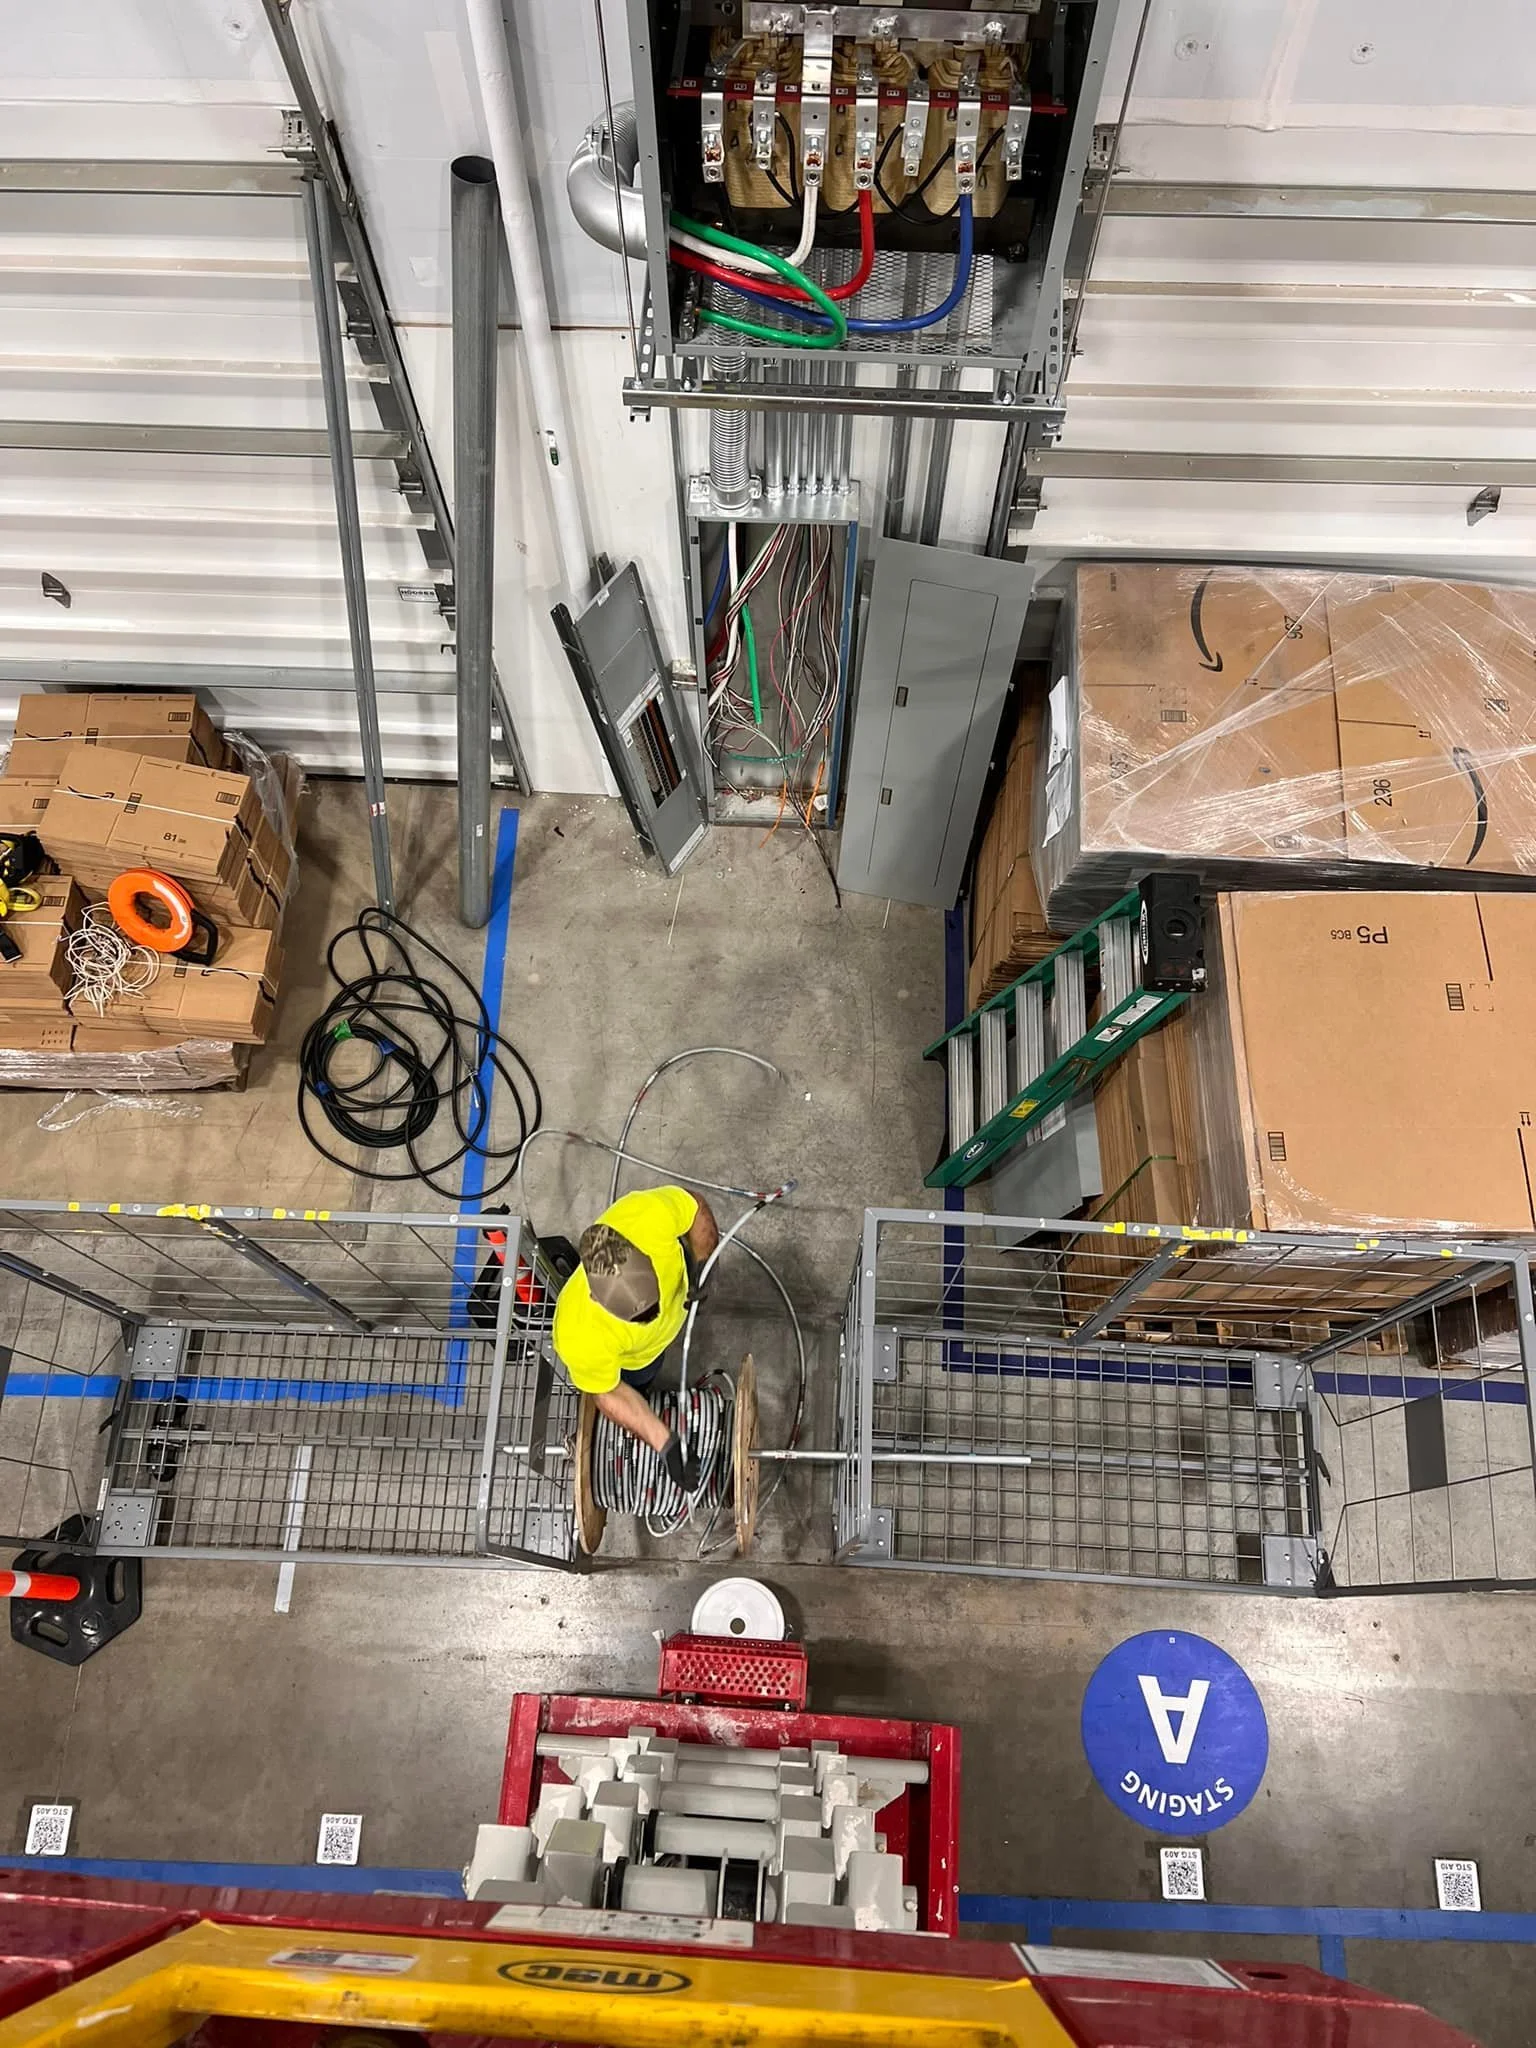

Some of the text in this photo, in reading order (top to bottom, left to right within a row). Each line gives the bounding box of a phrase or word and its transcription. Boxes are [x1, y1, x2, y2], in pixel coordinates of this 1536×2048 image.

[1372, 779, 1393, 807] 296
[163, 832, 177, 842] 81
[1330, 925, 1389, 944] P5 BC5
[1136, 1674, 1211, 1765] A
[1119, 1769, 1235, 1818] STAGING
